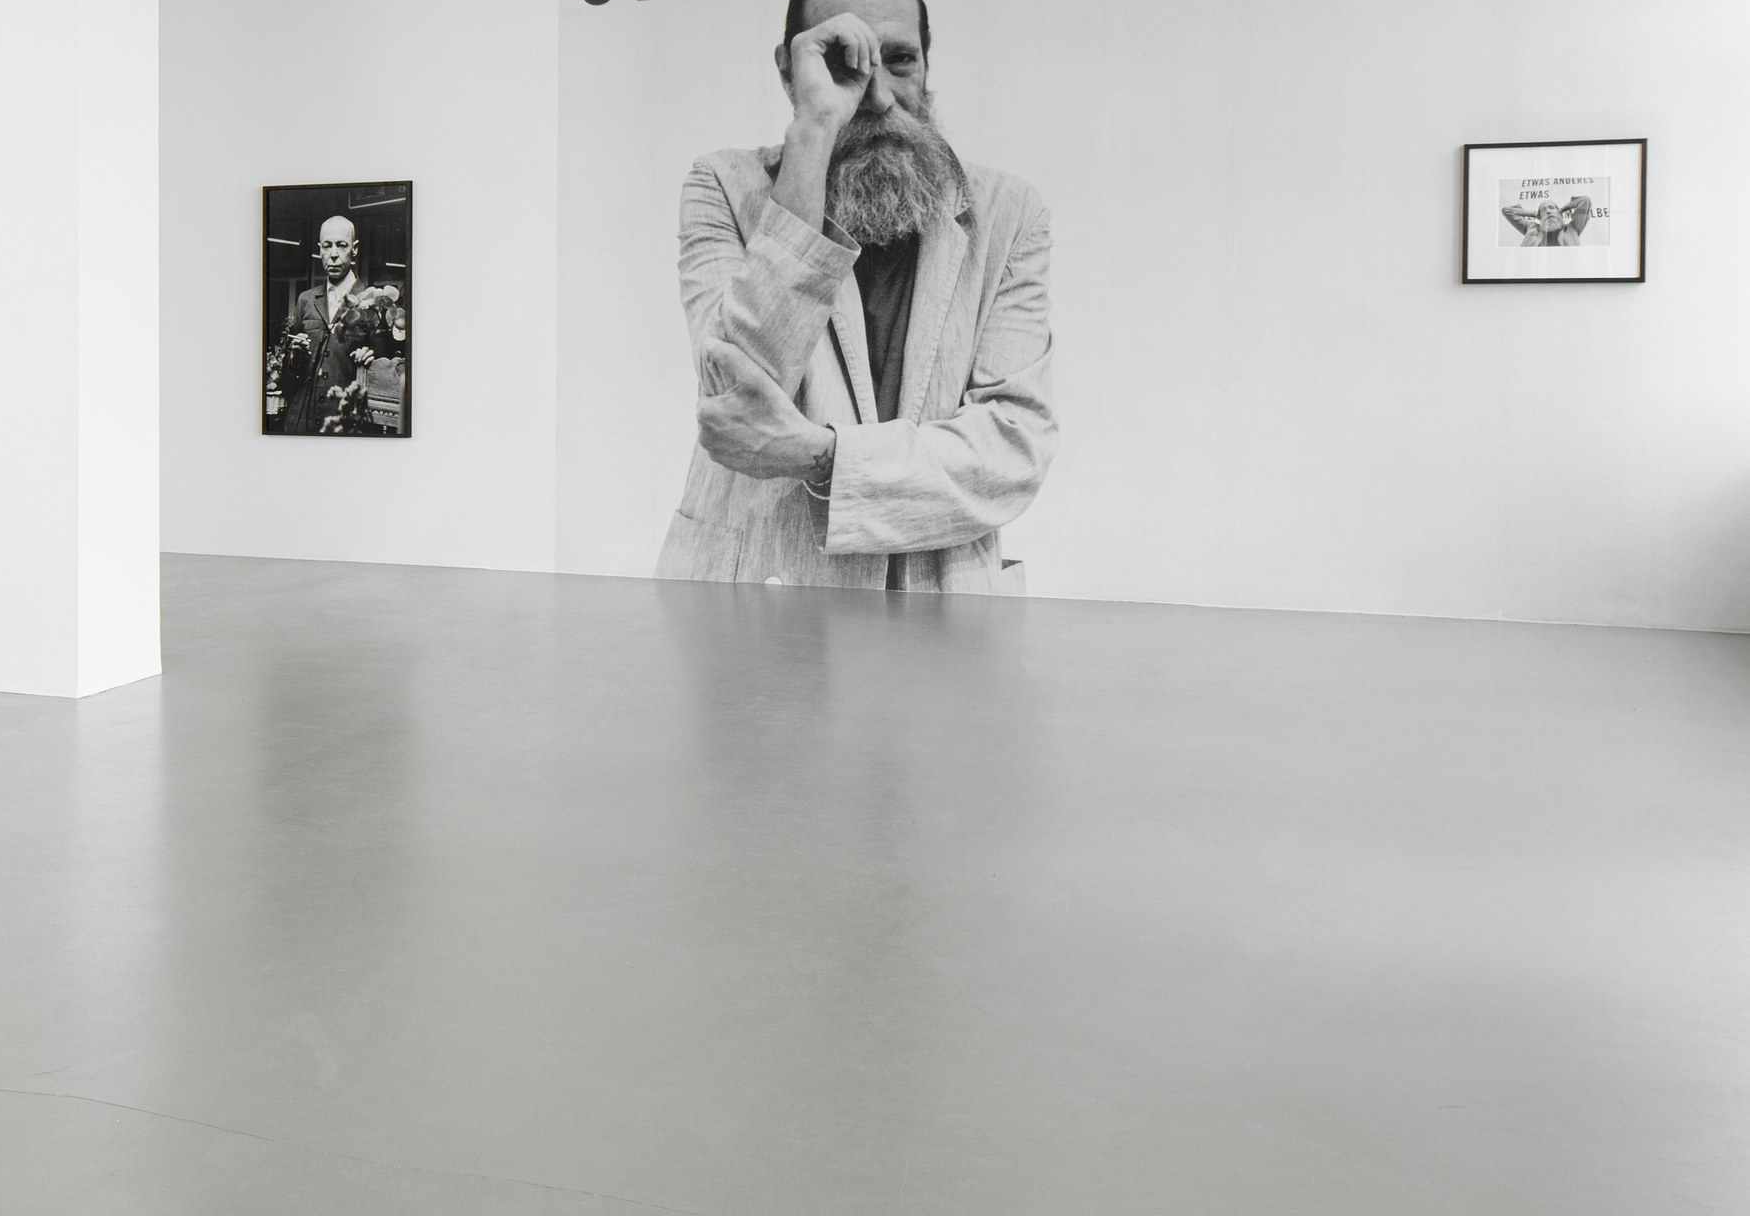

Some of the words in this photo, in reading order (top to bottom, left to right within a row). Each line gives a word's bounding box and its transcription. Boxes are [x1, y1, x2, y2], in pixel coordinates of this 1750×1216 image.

[1521, 178, 1550, 188] ETWAS
[1553, 177, 1594, 185] ANDERES
[1519, 190, 1549, 200] ETWAS
[1590, 207, 1610, 219] LBE
